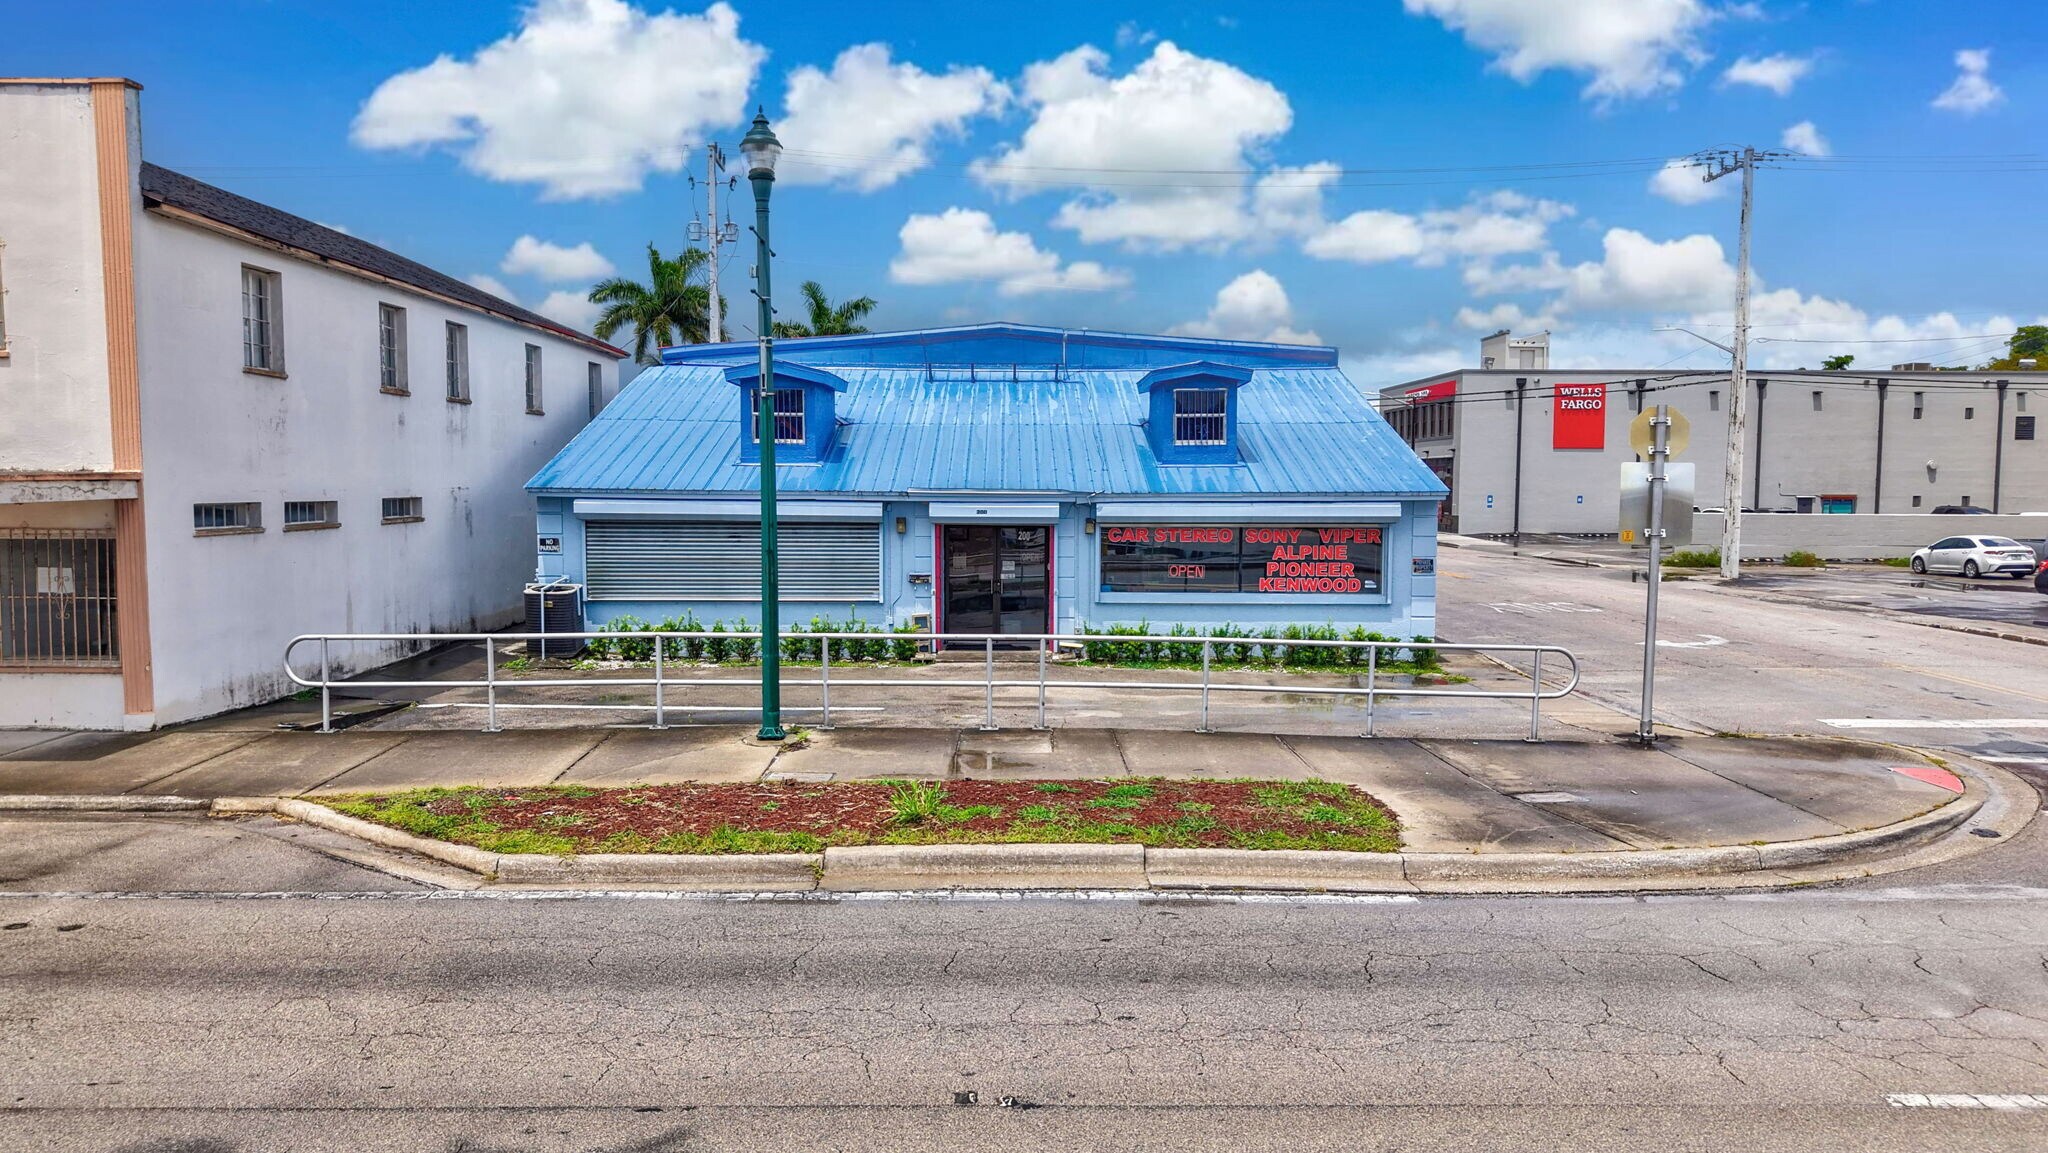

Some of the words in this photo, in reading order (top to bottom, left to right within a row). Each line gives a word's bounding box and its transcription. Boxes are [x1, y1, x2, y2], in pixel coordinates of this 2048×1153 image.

[1560, 387, 1602, 398] WELLS
[1560, 399, 1602, 410] FARGO
[1018, 531, 1031, 541] 200
[1108, 528, 1150, 543] CAR
[1154, 528, 1234, 543] STEREO
[1245, 528, 1301, 543] SONY
[1319, 528, 1381, 543] VIPER
[1272, 545, 1348, 560] ALPINE
[1169, 565, 1204, 578] OPEN
[1266, 562, 1355, 577] PIONEER
[1258, 577, 1361, 592] KENWOOD
